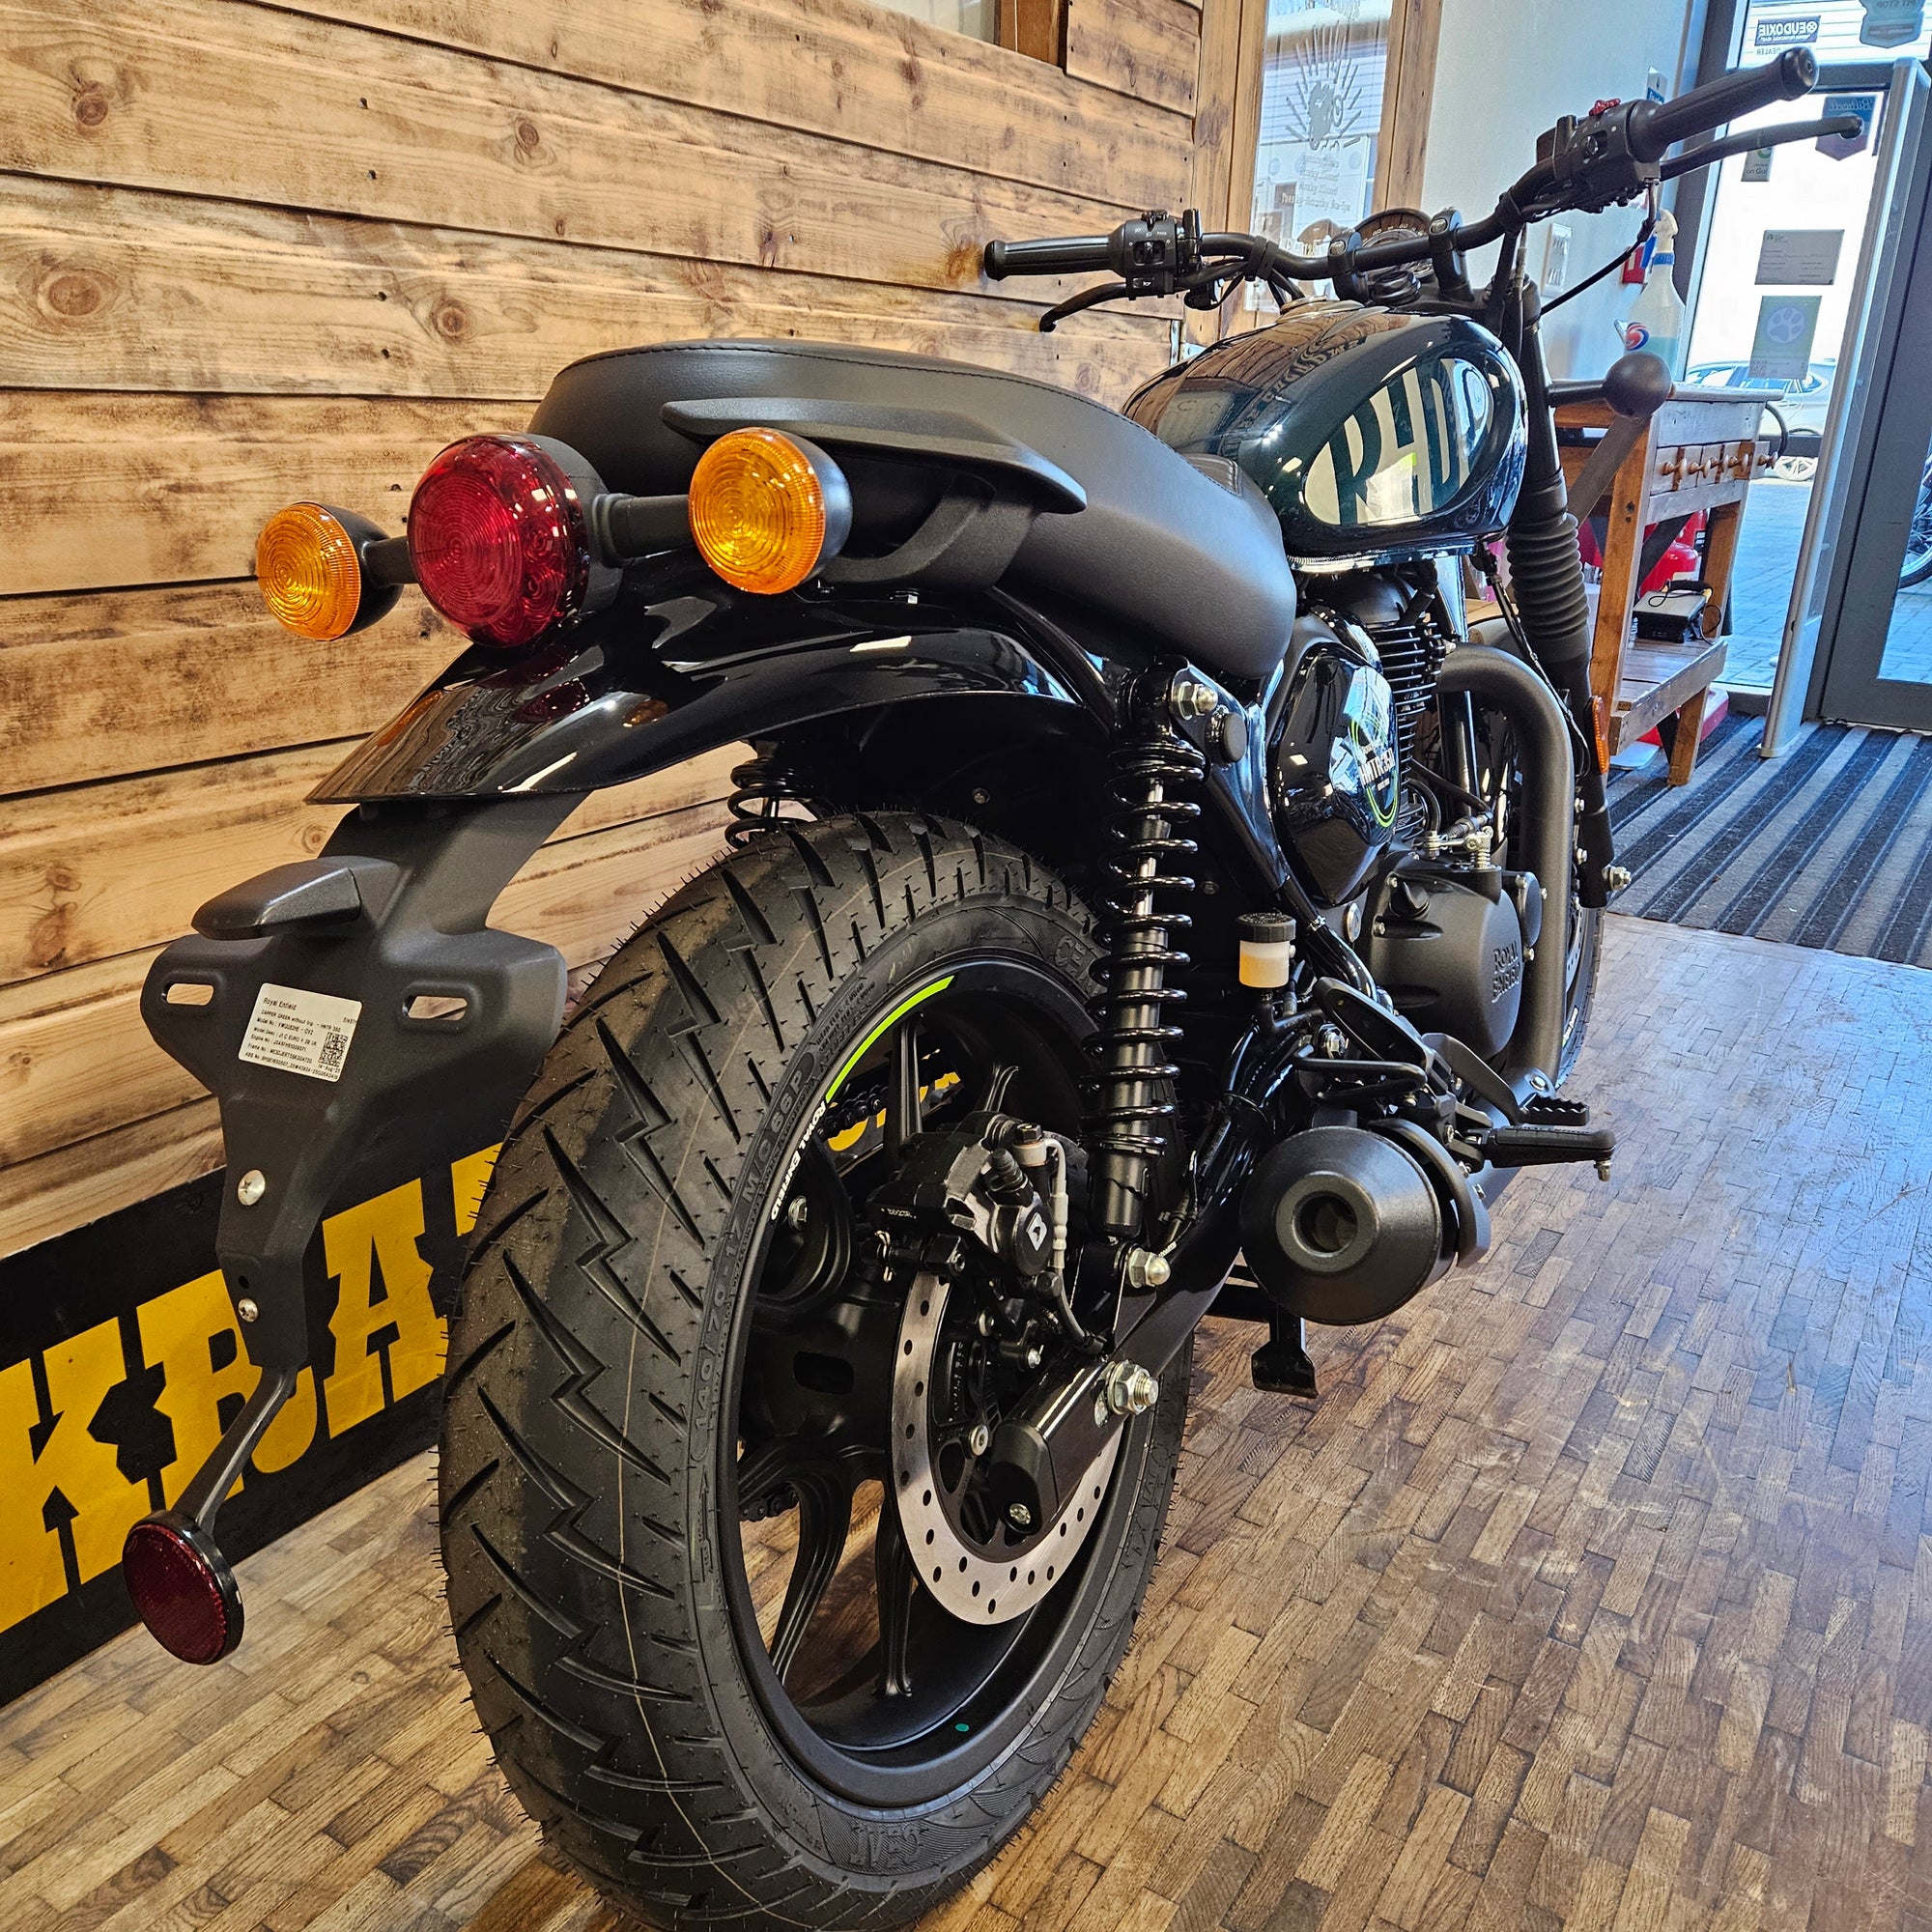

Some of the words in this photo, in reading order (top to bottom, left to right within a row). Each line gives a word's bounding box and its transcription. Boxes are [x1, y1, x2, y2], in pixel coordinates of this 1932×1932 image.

[263, 997, 277, 1007] Royal
[279, 1000, 297, 1009] Enfield
[798, 1100, 827, 1150] ROYAL
[771, 1150, 802, 1221] ENFIELD
[0, 1142, 502, 1634] KRA
